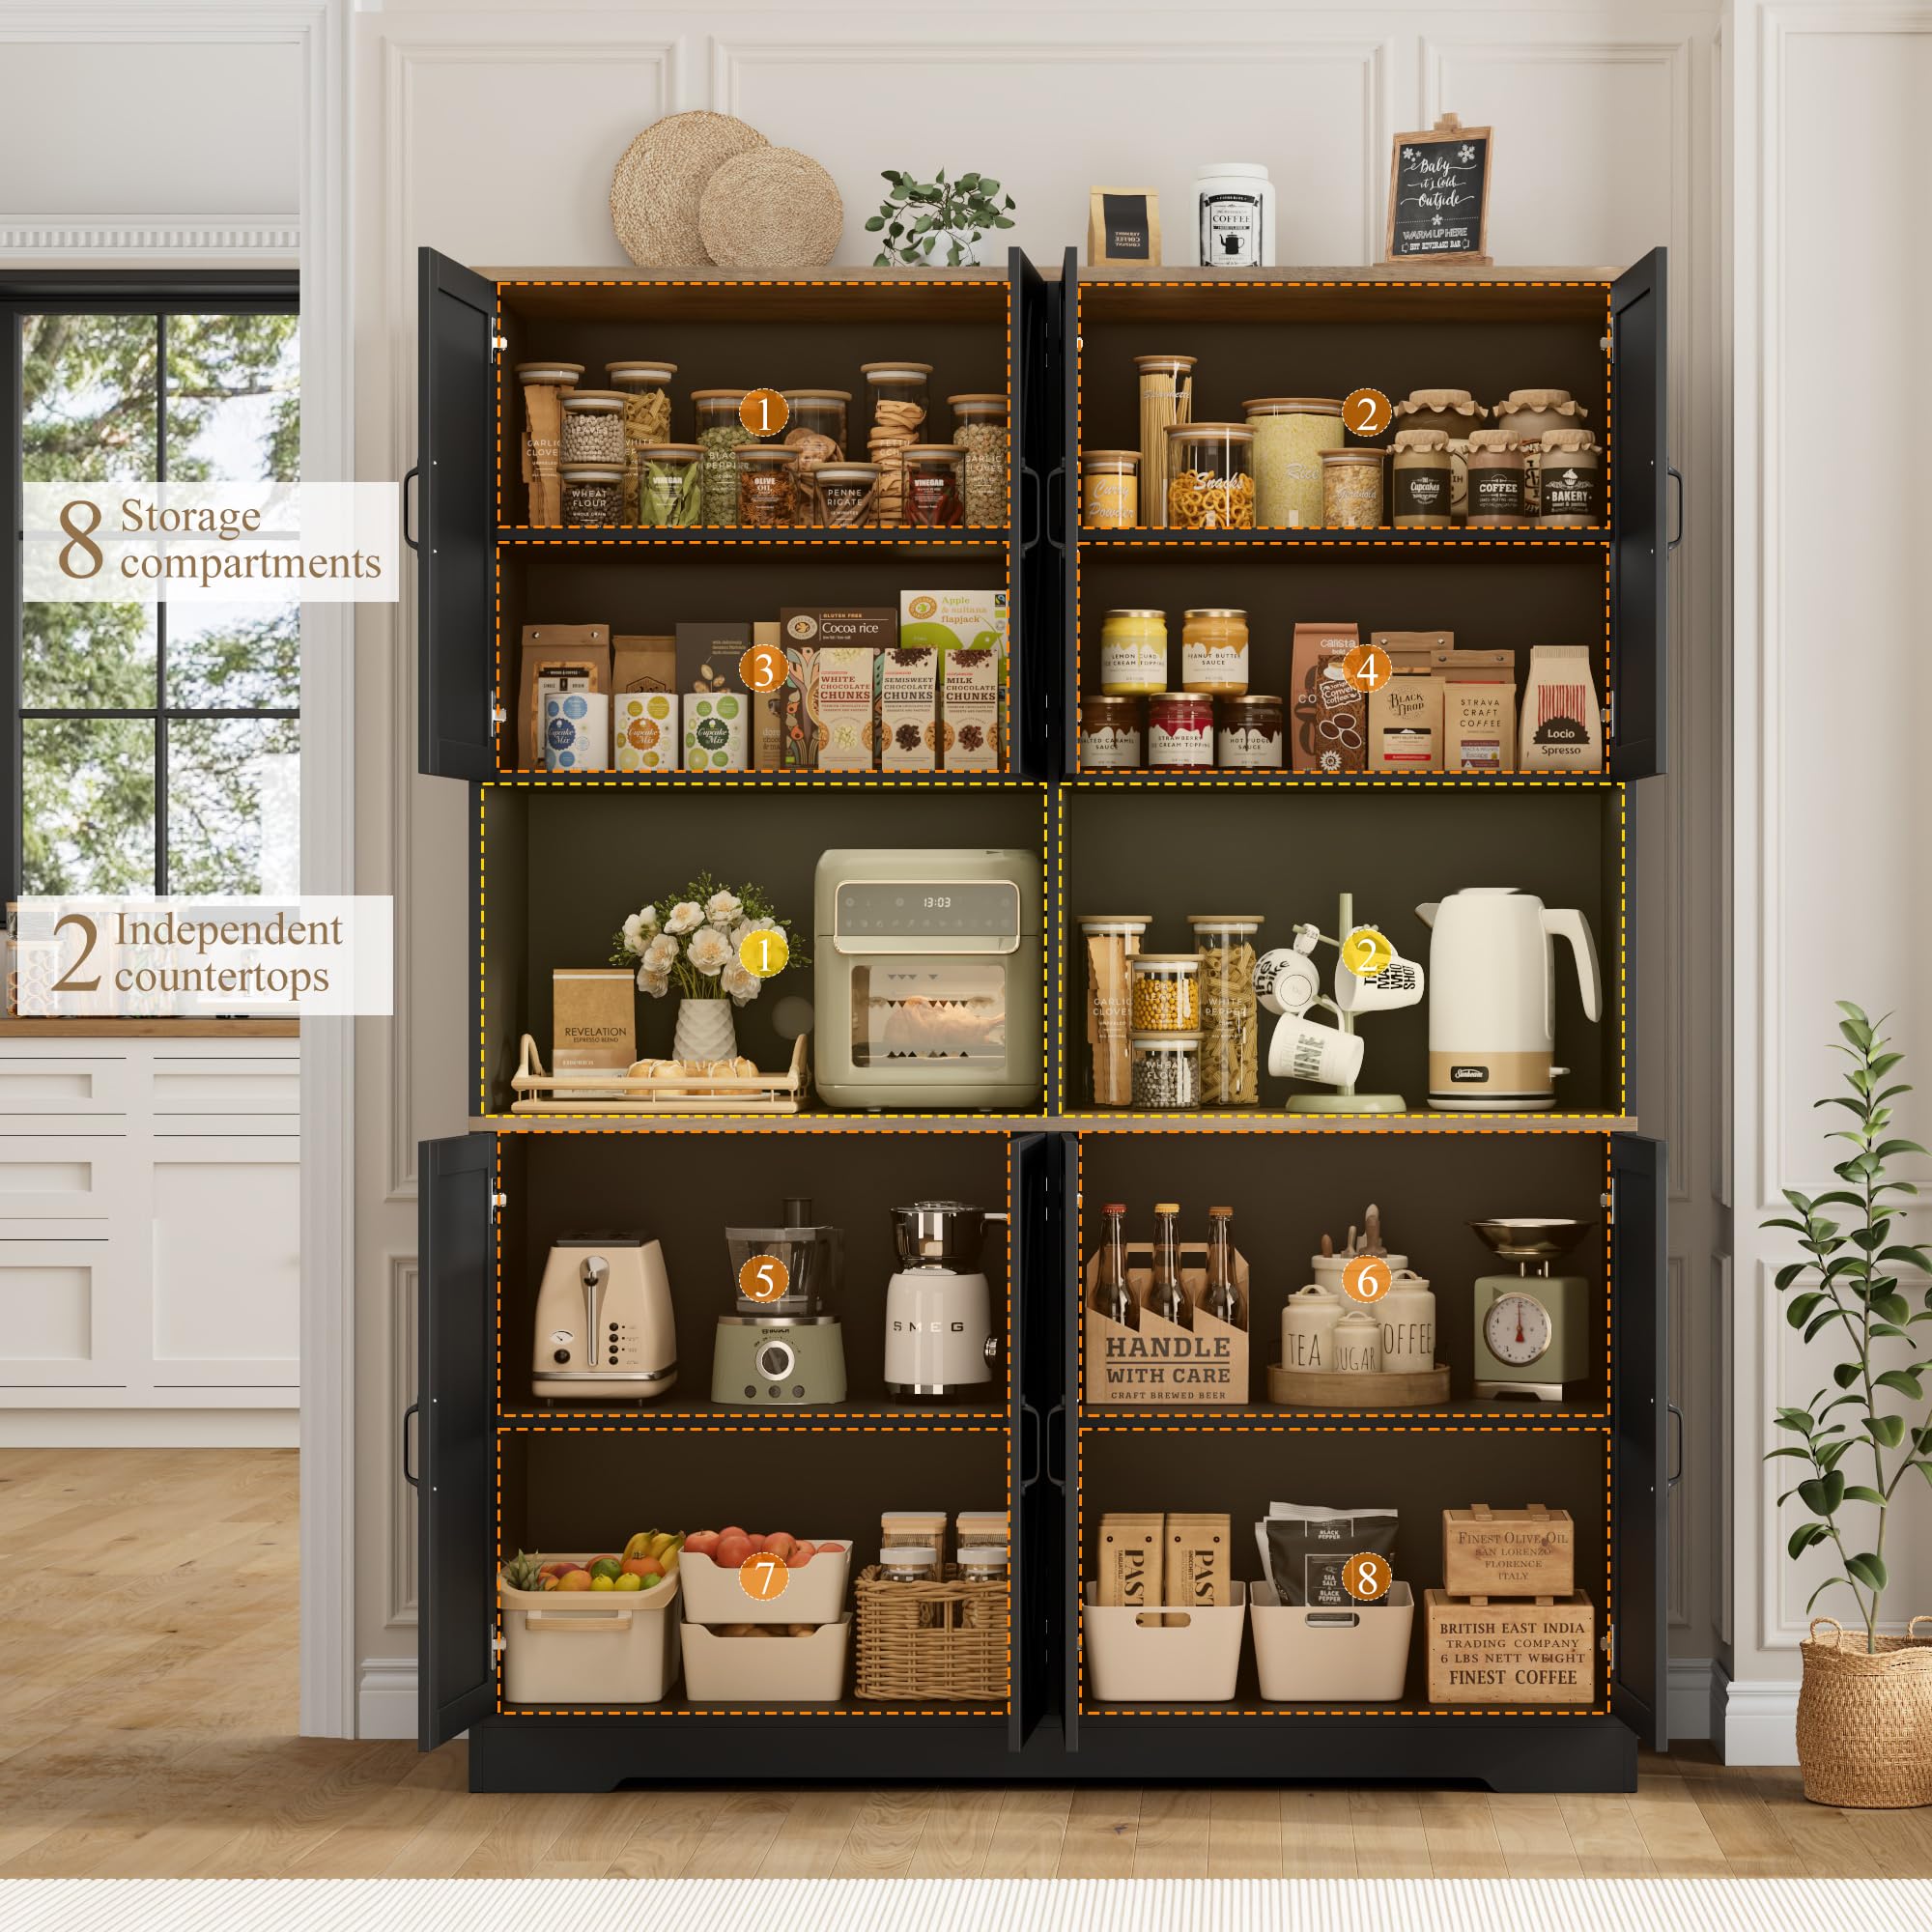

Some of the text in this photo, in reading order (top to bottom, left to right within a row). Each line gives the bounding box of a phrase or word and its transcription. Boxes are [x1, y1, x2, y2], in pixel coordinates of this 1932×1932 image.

[1408, 189, 1466, 210] Outside
[1403, 227, 1468, 241] WARM UP HERE
[1285, 462, 1320, 481] Rice
[914, 478, 944, 487] VINEGAR
[1193, 471, 1243, 491] Snacks
[1093, 478, 1128, 501] Curry
[1409, 482, 1440, 493] Cupcakes
[1479, 483, 1518, 493] COFFEE
[1551, 491, 1587, 501] BAKERY
[1088, 501, 1135, 519] Powder
[942, 597, 970, 606] Apple
[942, 615, 980, 624] flapjack
[822, 622, 857, 634] Cocoa
[859, 622, 879, 634] rice
[820, 691, 870, 699] CHUNKS
[884, 691, 933, 699] CHUNKS
[947, 692, 996, 700] CHUNKS
[1390, 693, 1424, 708] BLACK
[1398, 702, 1424, 716] DROP
[628, 728, 659, 737] Cupcake
[697, 728, 727, 737] Cupcake
[1548, 728, 1576, 738] Locio
[556, 735, 570, 744] Mix
[1541, 745, 1581, 756] Spresso
[923, 896, 952, 908] 13:03
[1390, 963, 1404, 990] WHO
[1403, 964, 1416, 990] SHOT
[565, 1027, 627, 1037] REVELATION
[1454, 1068, 1484, 1079] Sunbeam
[894, 1321, 964, 1332] SMEG
[1377, 1322, 1434, 1354] OFFEE
[1105, 1337, 1231, 1358] HANDLE
[1288, 1333, 1321, 1366] TEA
[1335, 1346, 1377, 1371] SUGAR
[1106, 1368, 1231, 1383] WITH CARE
[1501, 1548, 1551, 1556] LORENZO
[1485, 1560, 1543, 1569] FLORENCE
[1124, 1549, 1144, 1606] PAST
[1195, 1550, 1214, 1606] PAST
[1440, 1623, 1585, 1634] BRITISH EAST INDIA
[1446, 1639, 1580, 1648] TRADING COMPANY
[1440, 1654, 1586, 1663] 6 LBS NETT WEIGHT
[1449, 1670, 1577, 1685] FINEST COFFEE
